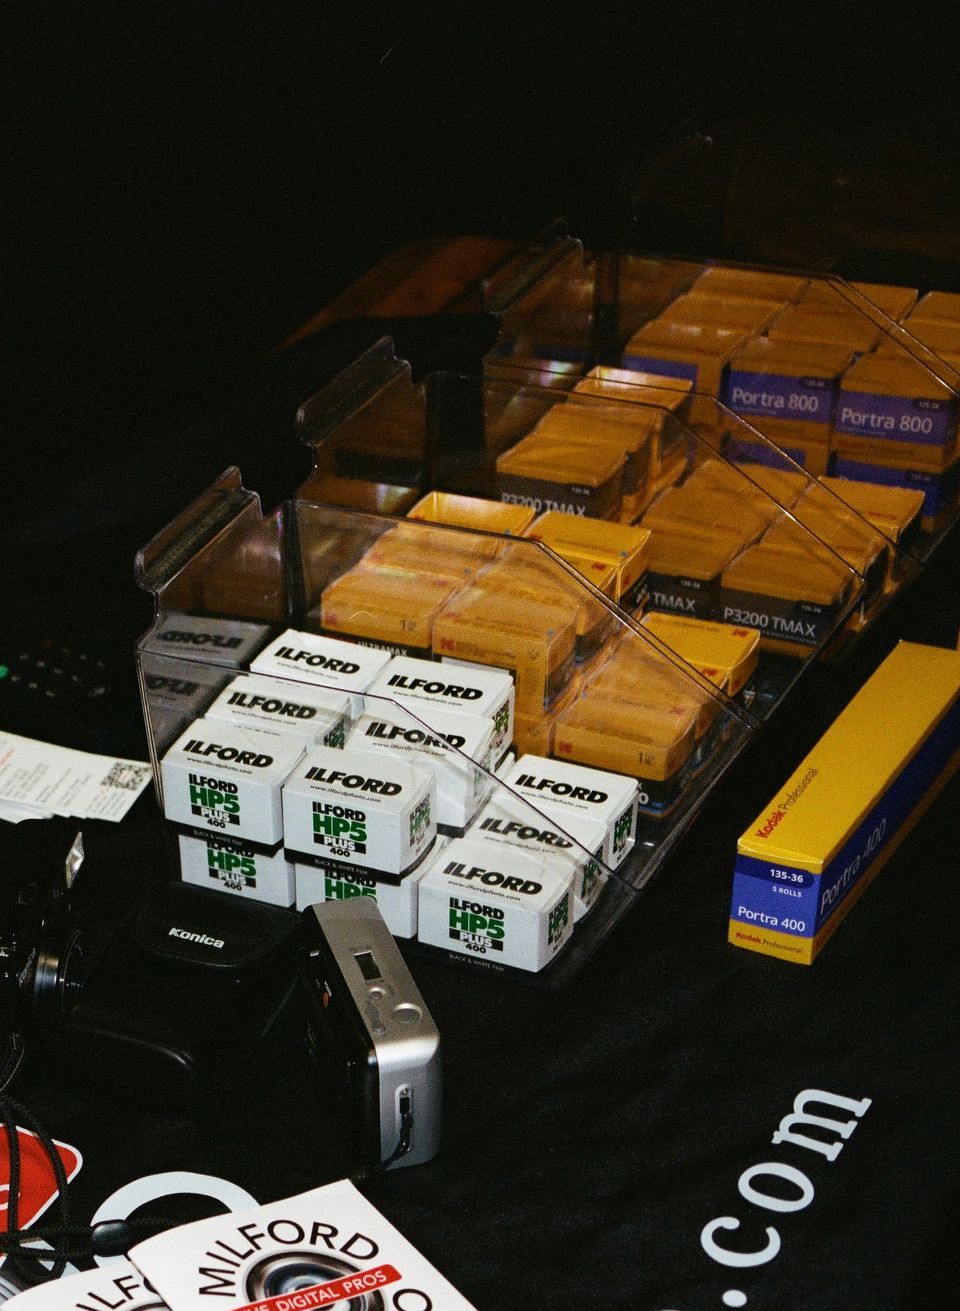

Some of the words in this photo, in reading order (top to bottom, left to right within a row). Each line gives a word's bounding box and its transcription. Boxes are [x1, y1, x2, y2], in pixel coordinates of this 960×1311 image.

[732, 388, 785, 409] Portra
[788, 393, 819, 412] 800
[841, 407, 895, 429] Portra
[899, 415, 933, 433] 800
[652, 592, 696, 612] TMAX
[724, 607, 769, 628] P3200
[771, 616, 816, 638] TMAX
[274, 646, 360, 674] ILFORD
[387, 674, 483, 700] ILFORD
[227, 692, 318, 720] ILFORD
[365, 721, 466, 753] ILFORD
[183, 739, 274, 768] ILFORD
[188, 773, 238, 794] ILFORD
[305, 767, 402, 796] ILFORD
[310, 785, 381, 803] www.ilfordphoto.com
[515, 774, 608, 804] ILFORD
[190, 785, 240, 813] HP5
[312, 801, 366, 822] ILFORD
[755, 809, 786, 839] Kodak
[781, 767, 819, 812] Professional
[201, 809, 230, 823] PLUS
[207, 818, 226, 828] 400
[313, 813, 367, 842] HP5
[324, 837, 356, 850] PLUS
[479, 818, 574, 849] ILFORD
[208, 848, 256, 877] HP5
[330, 849, 350, 857] 400
[218, 872, 247, 885] PLUS
[224, 881, 242, 891] 400
[443, 861, 543, 896] ILFORD
[769, 868, 804, 884] 135-36
[448, 880, 521, 902] www.ilfordphoto.com
[779, 887, 802, 898] ROLLS
[449, 897, 505, 920] ILFORD
[738, 906, 778, 927] Portra
[781, 916, 806, 932] 400
[449, 909, 505, 940] HP5
[168, 926, 225, 949] Konica
[460, 932, 493, 948] PLUS
[465, 944, 487, 954] 400
[736, 931, 761, 945] Kodak
[762, 938, 803, 954] Professional
[198, 1219, 380, 1298] MILFORD
[342, 1269, 387, 1295] PROS
